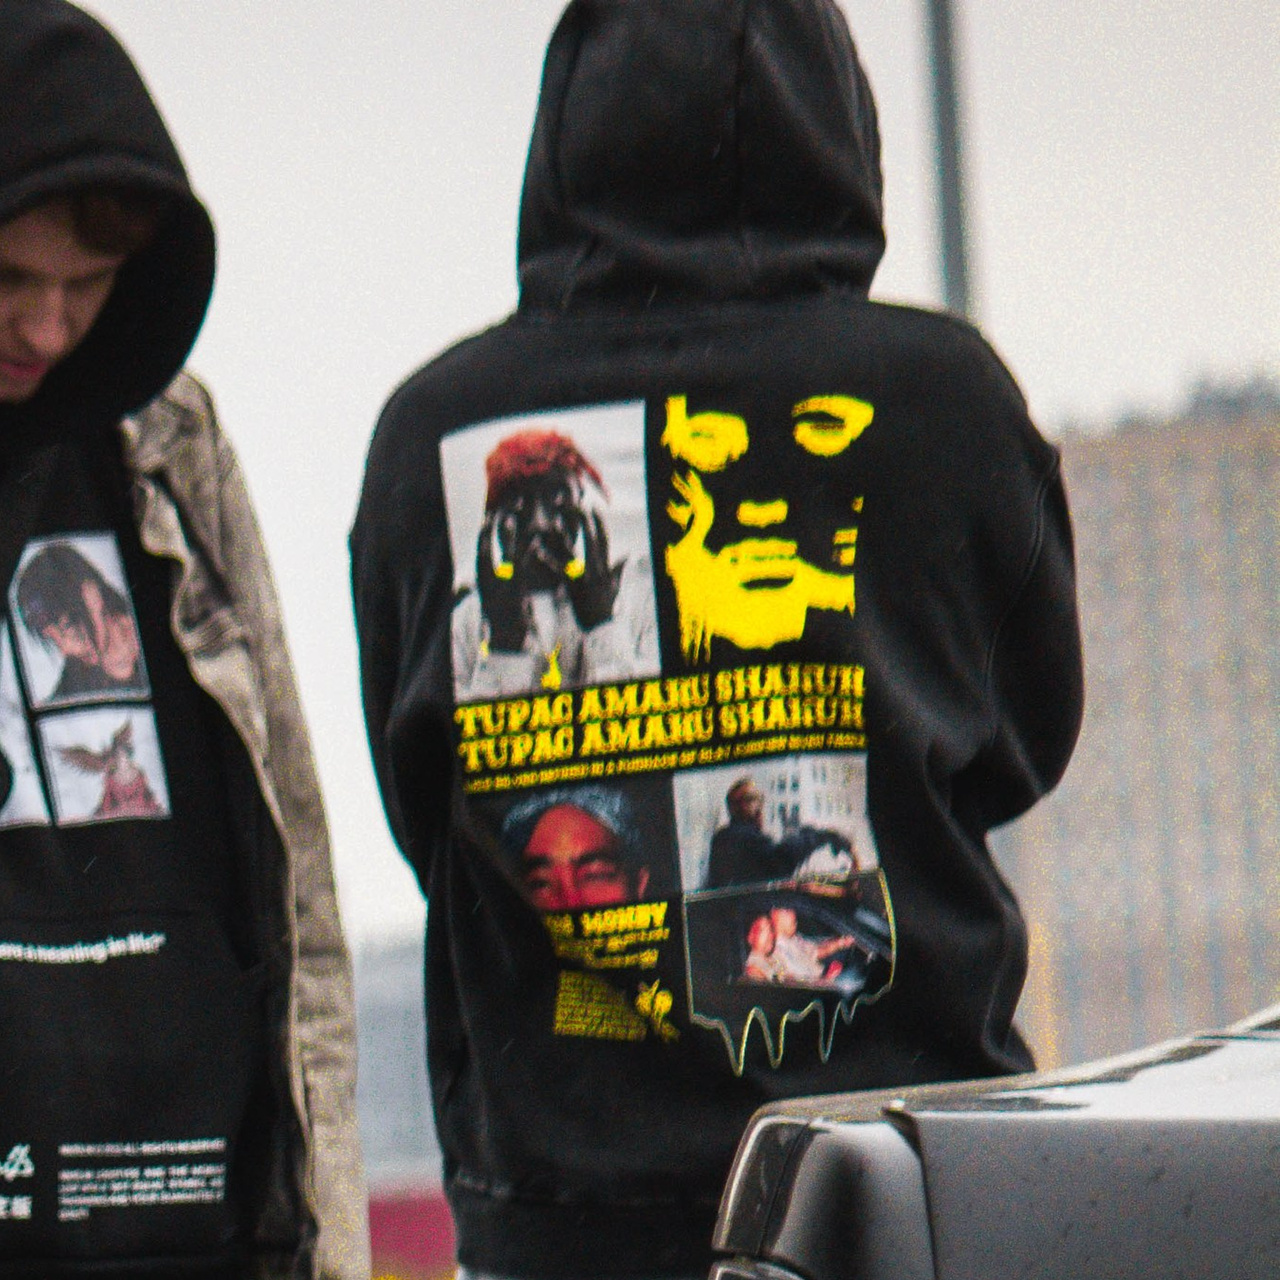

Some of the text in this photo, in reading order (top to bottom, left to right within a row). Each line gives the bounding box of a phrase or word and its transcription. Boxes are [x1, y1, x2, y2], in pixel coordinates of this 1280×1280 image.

[453, 663, 866, 738] TUPAC AMARU SHAKUR
[457, 725, 575, 773] TUPAC
[579, 706, 715, 757] AMARU
[720, 697, 866, 738] SHAKUR
